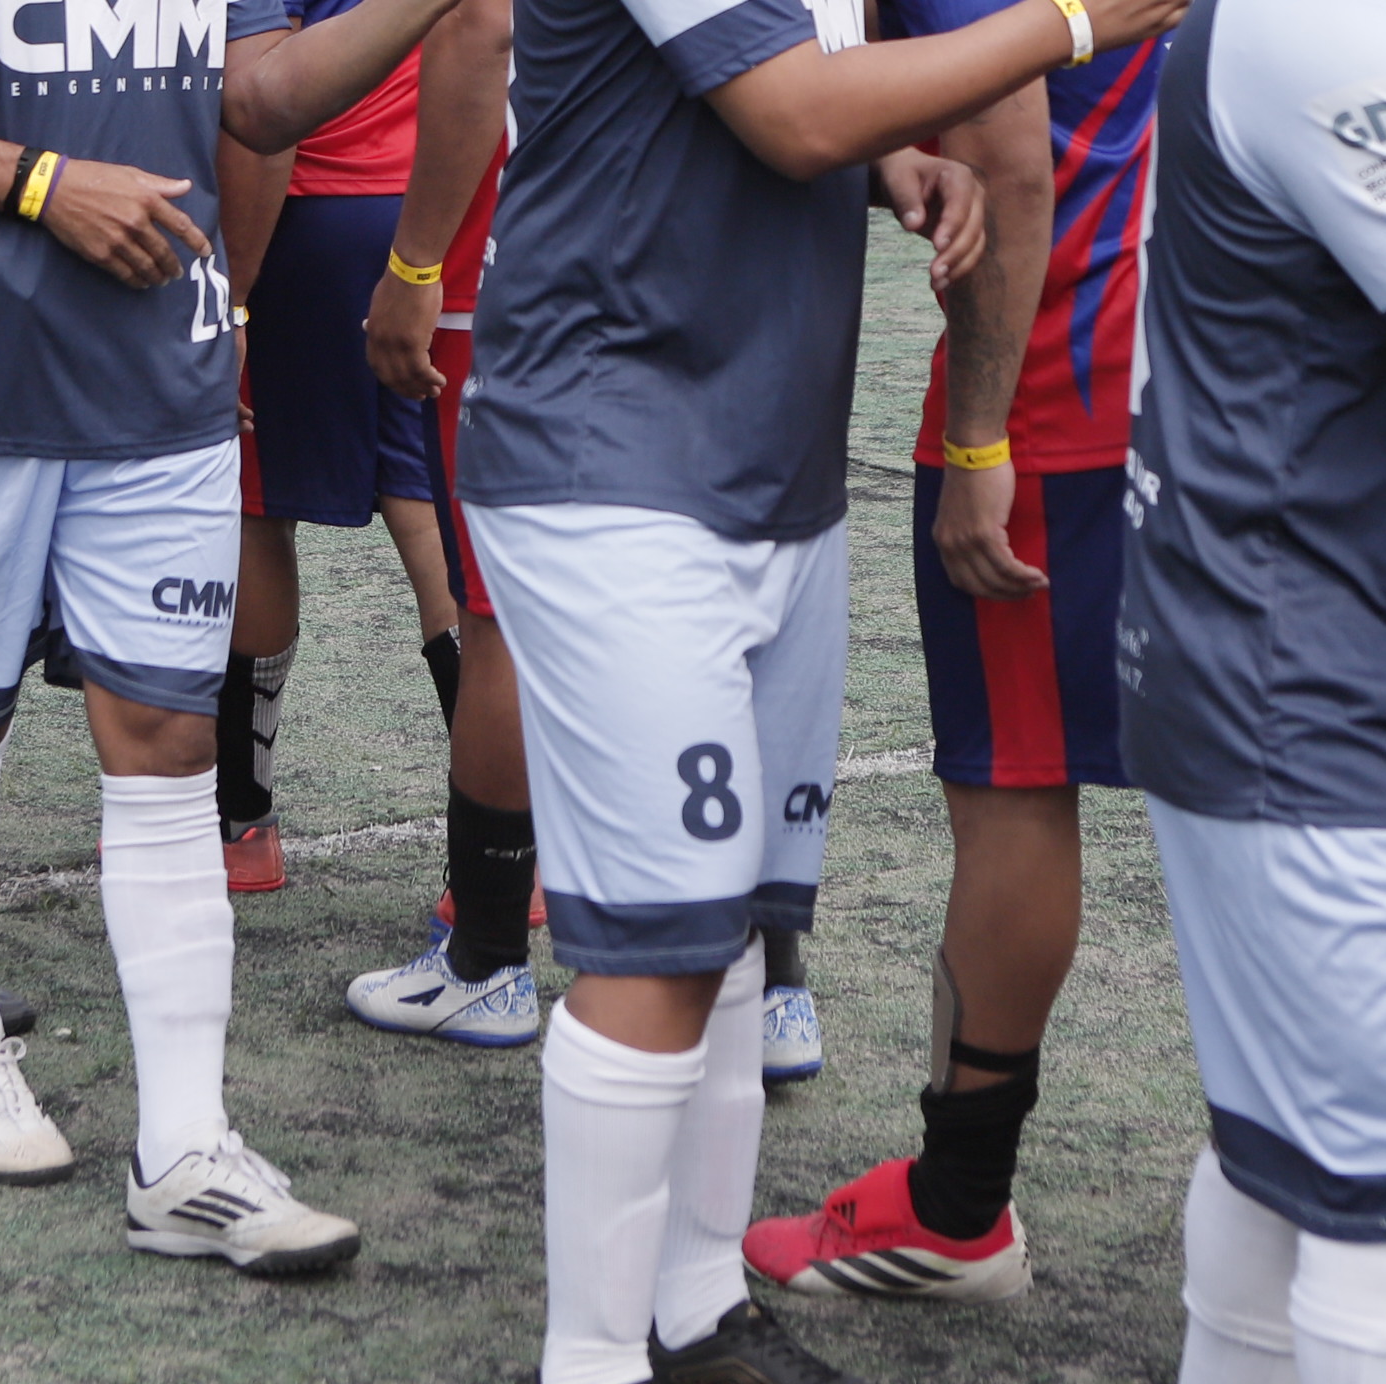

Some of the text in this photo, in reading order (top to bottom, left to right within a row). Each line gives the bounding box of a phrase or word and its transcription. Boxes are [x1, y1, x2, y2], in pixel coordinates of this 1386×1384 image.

[11, 75, 224, 96] ENGENHARIA
[152, 577, 235, 619] CMM
[677, 742, 742, 841] 8
